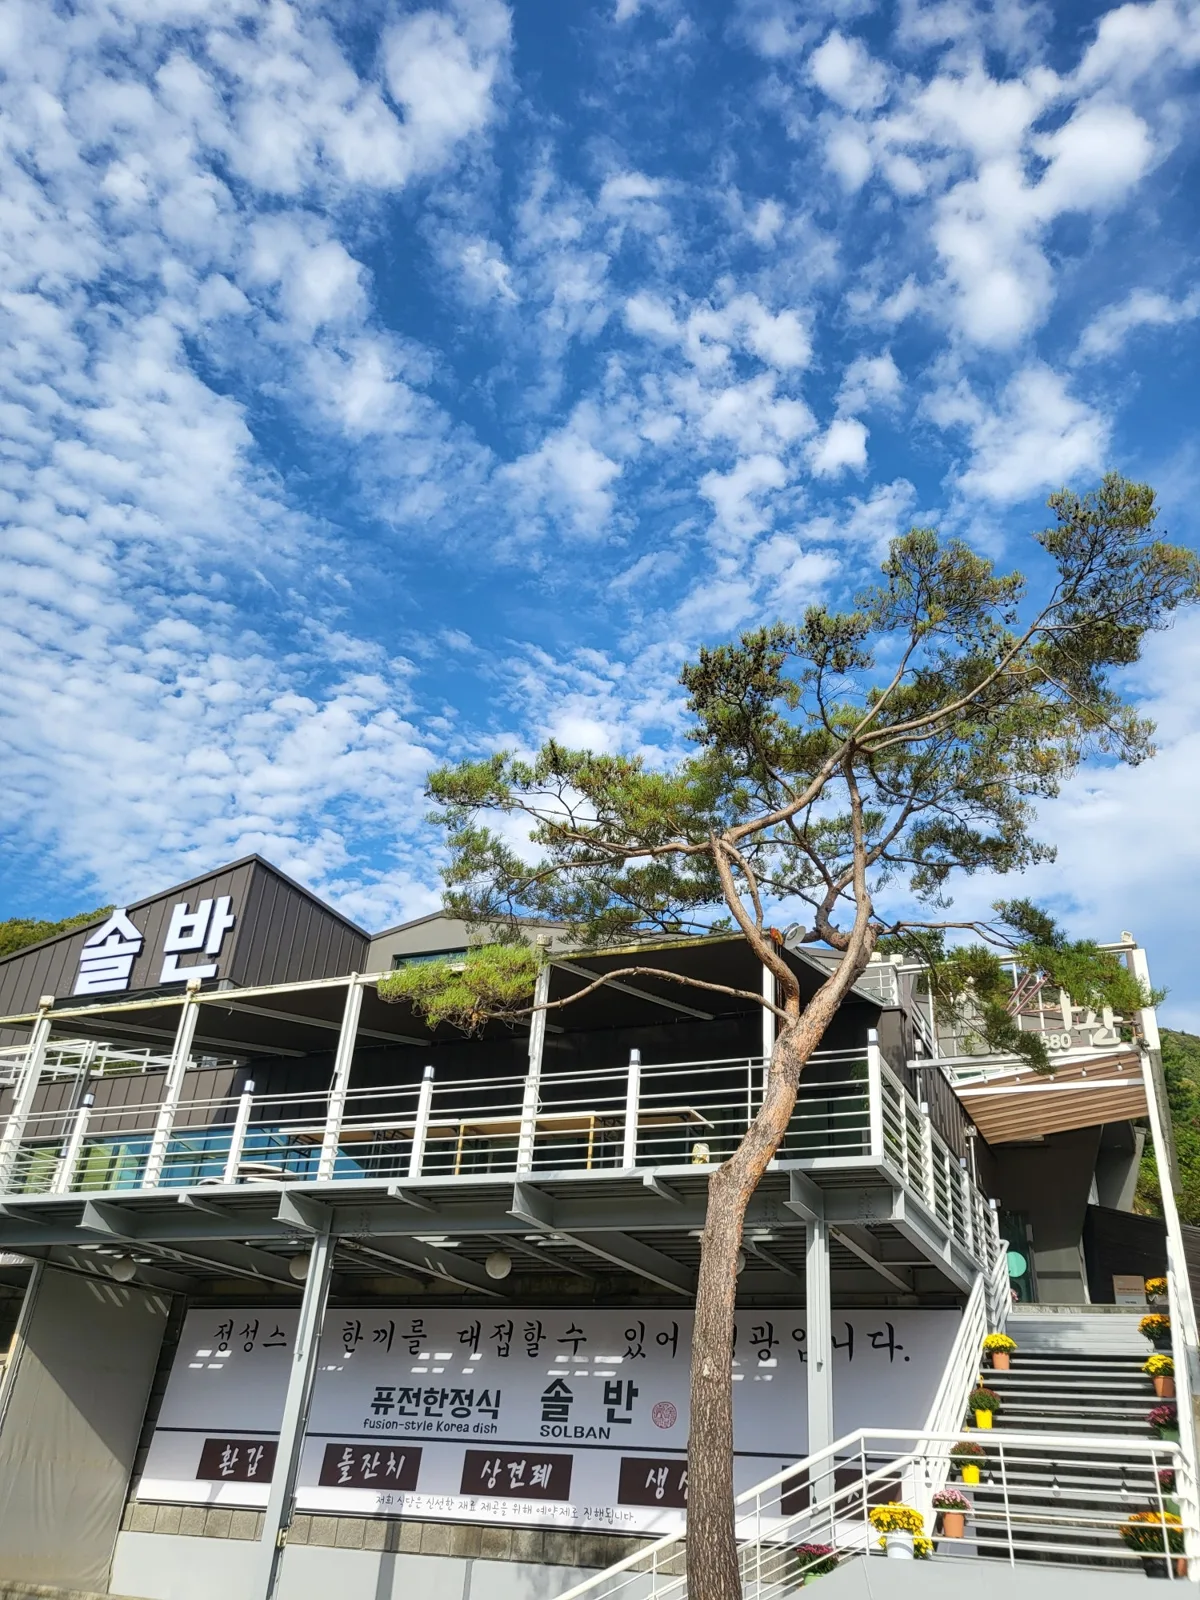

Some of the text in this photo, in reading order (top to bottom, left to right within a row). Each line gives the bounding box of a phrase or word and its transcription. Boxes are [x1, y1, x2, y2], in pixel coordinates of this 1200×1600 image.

[73, 895, 236, 996] 솔반
[213, 1318, 288, 1353] 정성스
[342, 1319, 428, 1356] 한끼를
[456, 1319, 547, 1358] 대접할
[622, 1320, 680, 1360] 있어
[732, 1320, 910, 1363] 광입니다.
[370, 1386, 502, 1420] 퓨전한정식
[363, 1418, 498, 1435] fusion-style Korea dish
[539, 1424, 611, 1440] SOLBAN
[218, 1444, 264, 1478] 환갑
[336, 1447, 406, 1484] 돌잔치
[480, 1458, 553, 1490] 상견례
[376, 1494, 637, 1525] 저희 식당은 신선한 재료 제공을 위해 예약제로 진행됩니다.
